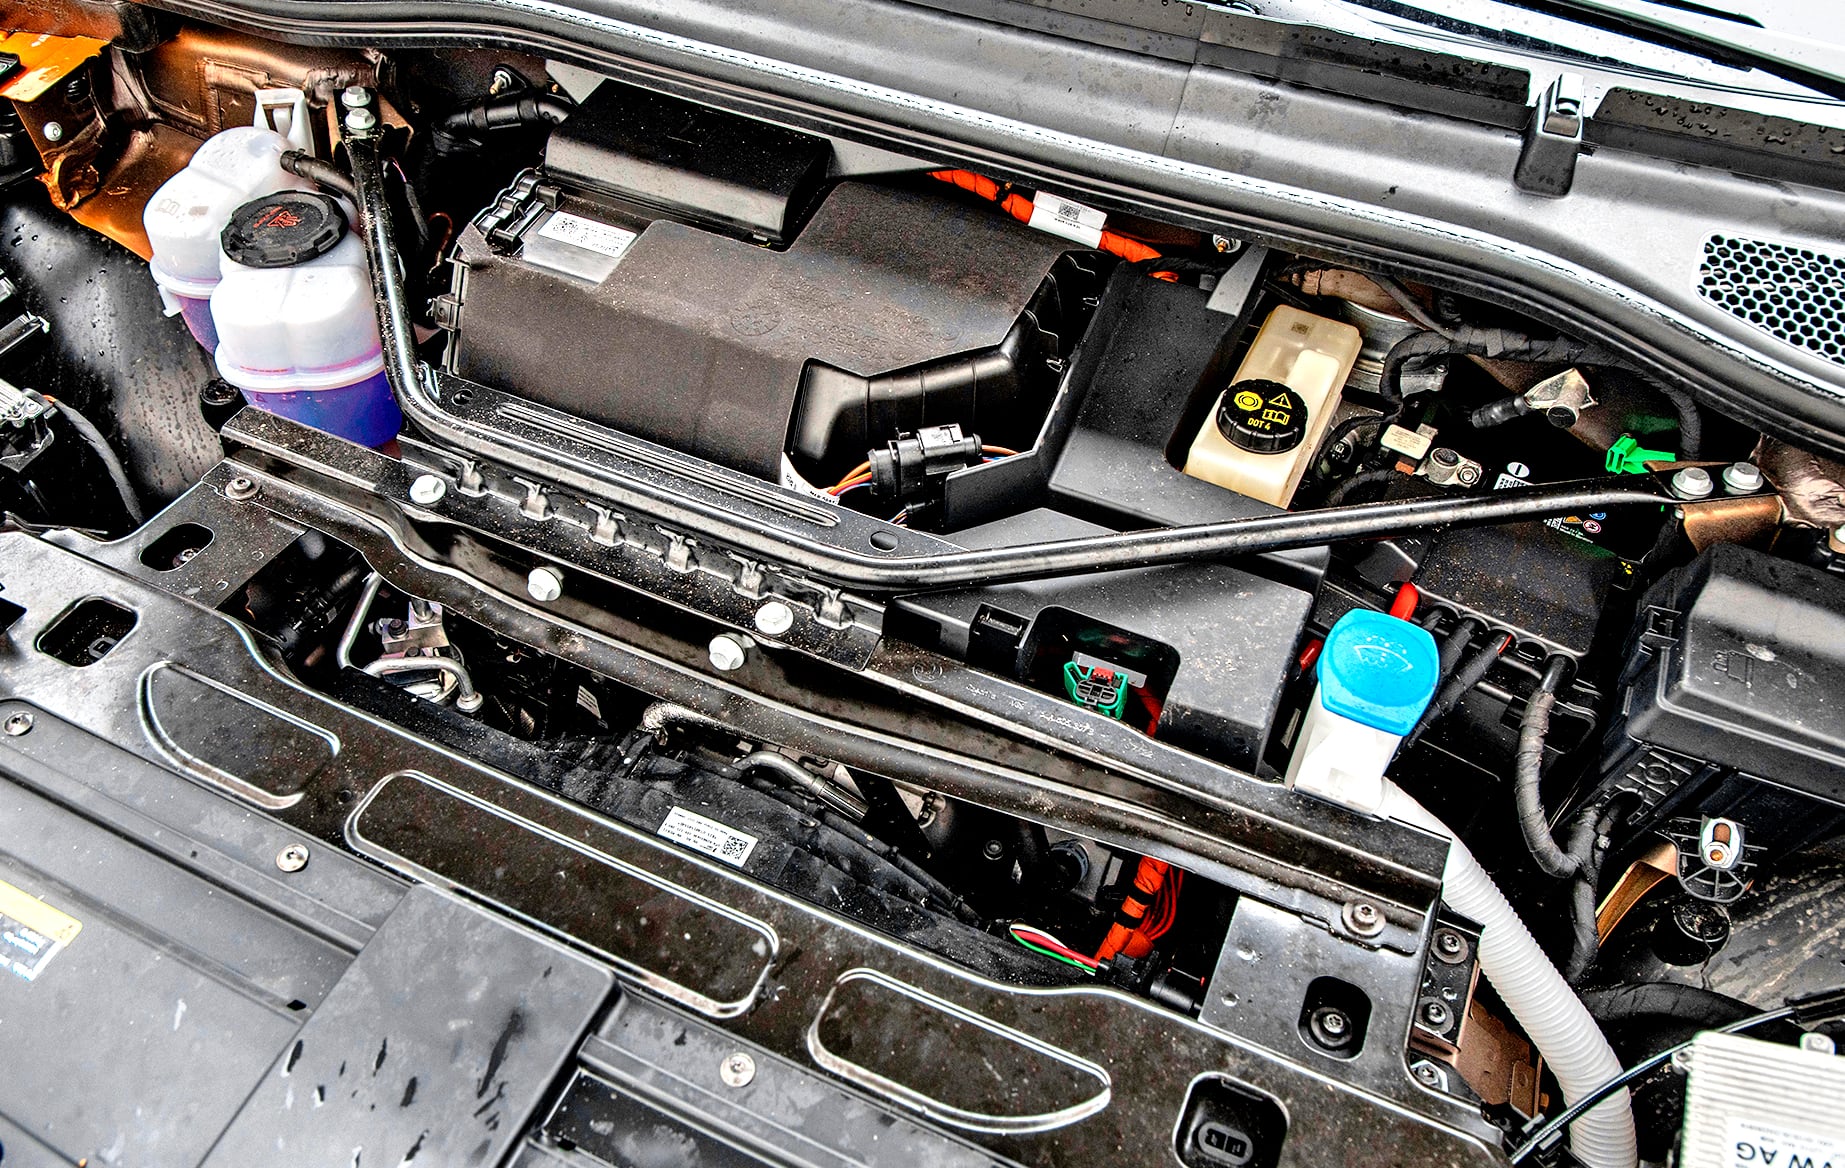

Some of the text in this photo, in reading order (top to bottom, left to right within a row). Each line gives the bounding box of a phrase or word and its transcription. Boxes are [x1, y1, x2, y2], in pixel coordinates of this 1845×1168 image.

[1247, 417, 1271, 431] DOT 4
[1737, 1142, 1778, 1165] AG
